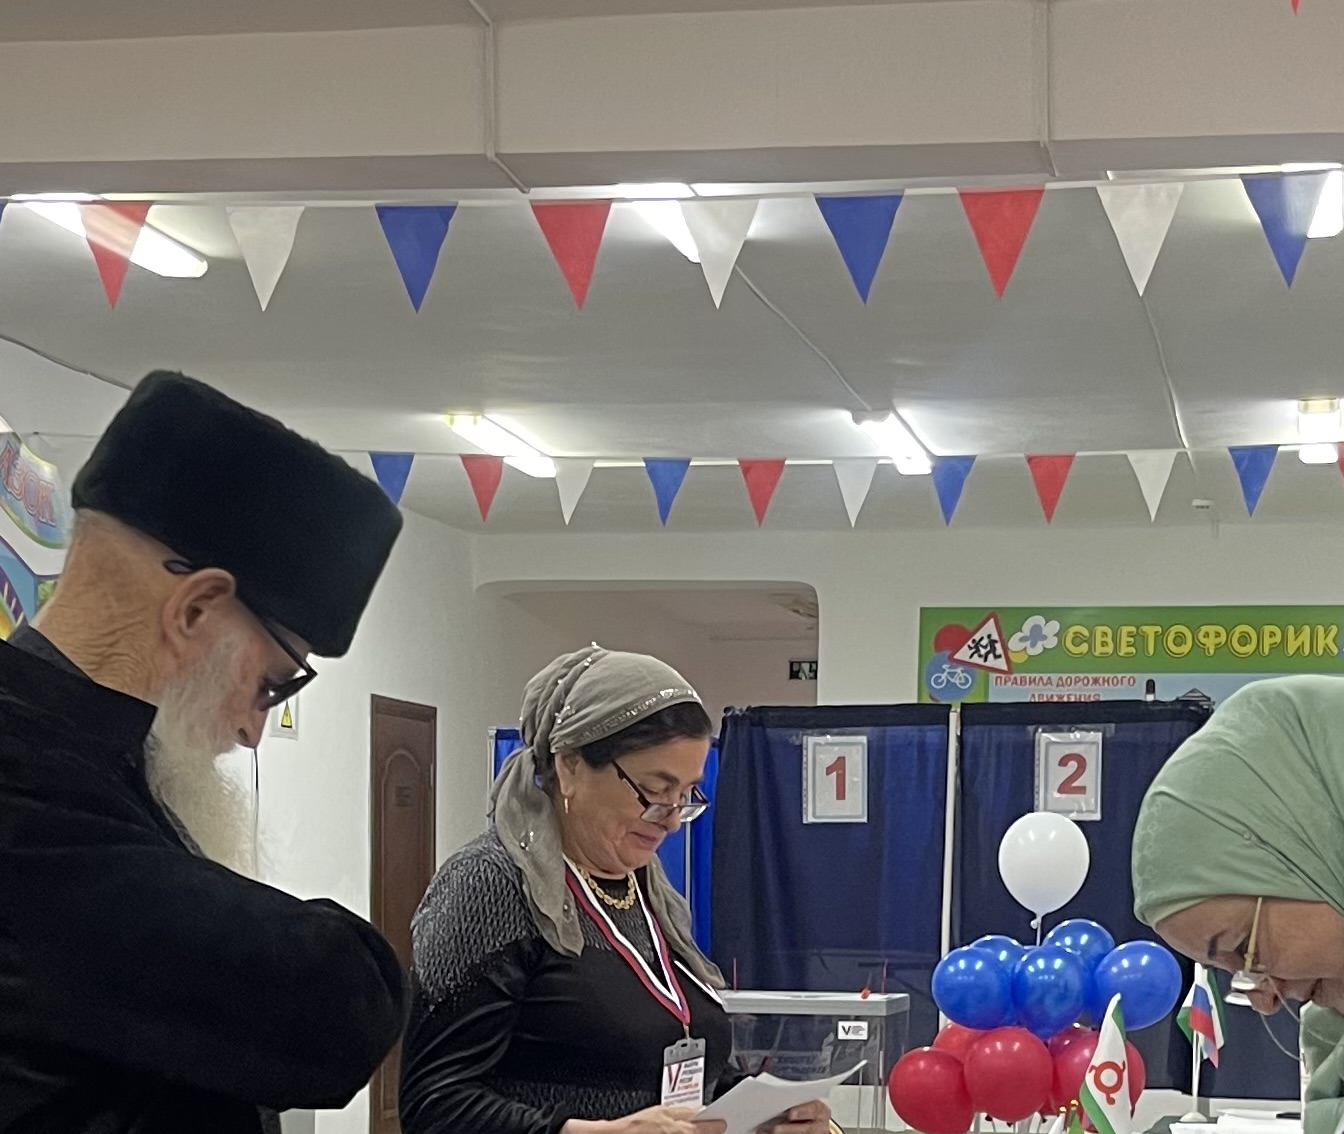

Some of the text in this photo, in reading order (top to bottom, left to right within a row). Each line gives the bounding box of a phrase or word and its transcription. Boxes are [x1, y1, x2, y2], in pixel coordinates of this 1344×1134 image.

[1062, 623, 1340, 659] СВЕТОФОРИК
[994, 675, 1136, 688] ПРАВИЛА ДОРОЖНОГО
[825, 755, 846, 800] 1
[1057, 752, 1087, 795] 2
